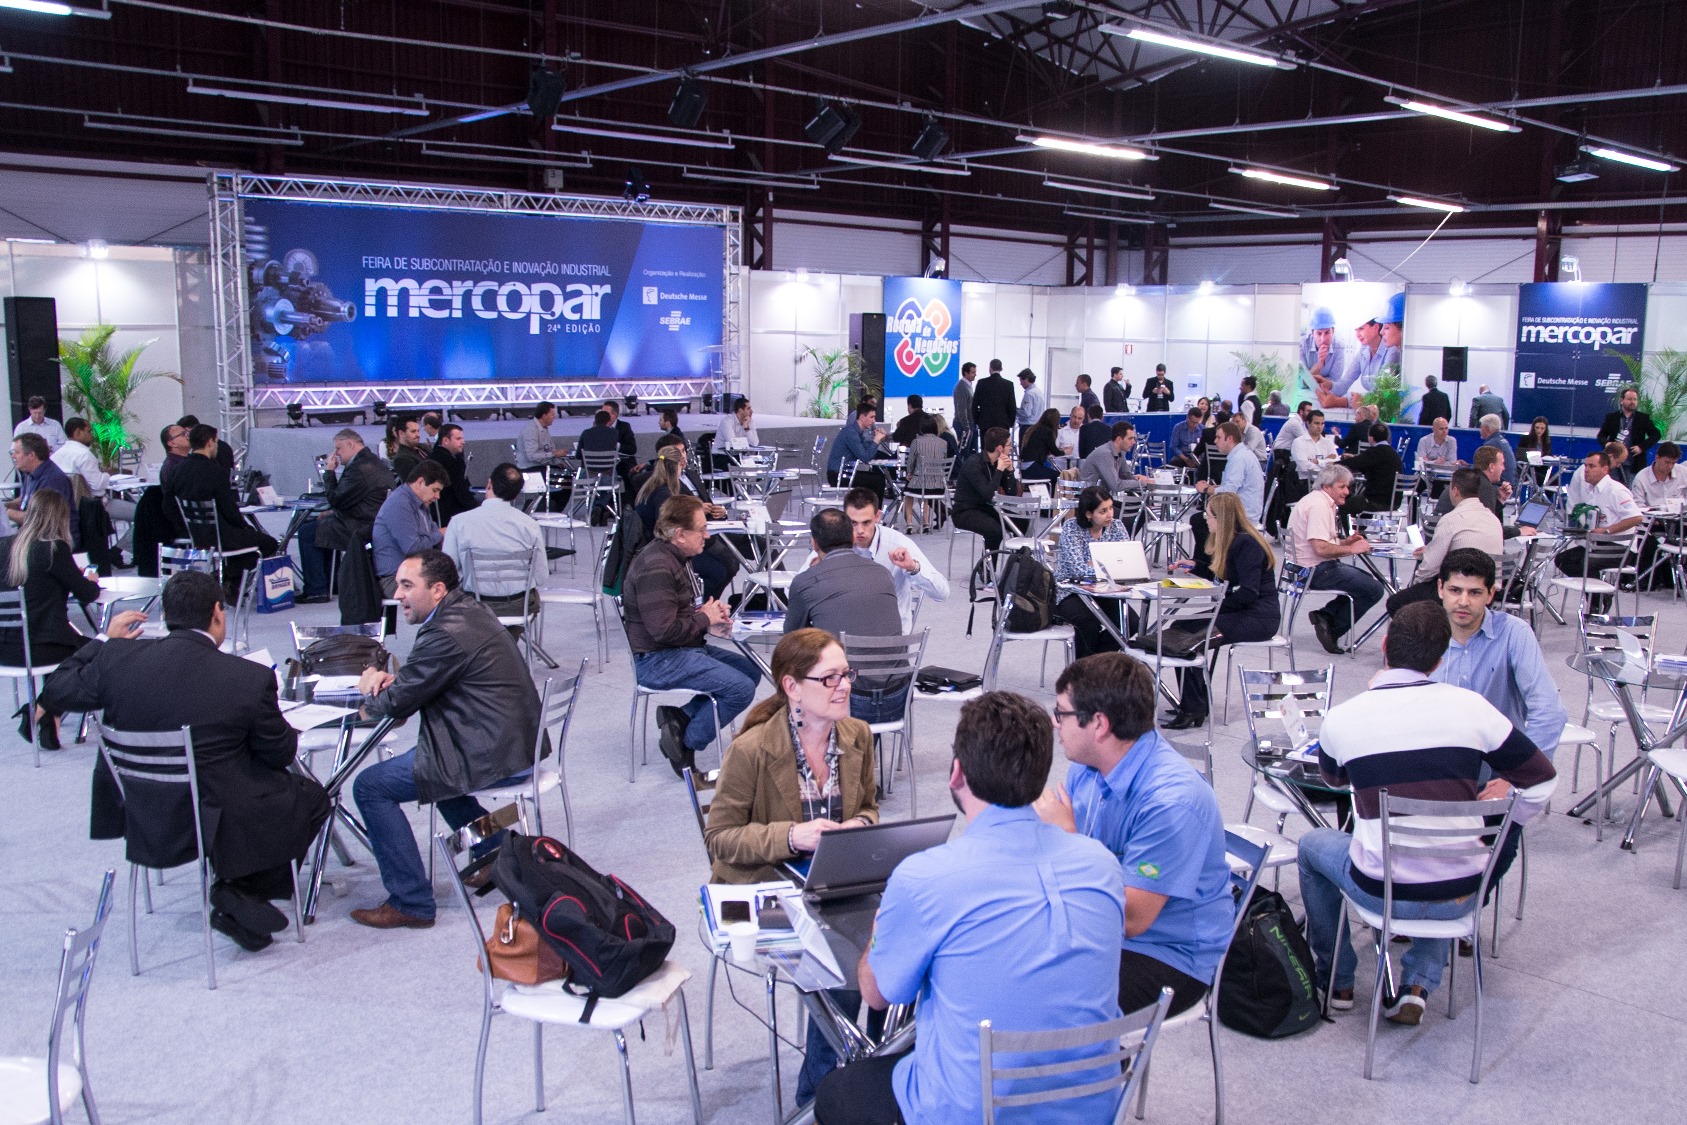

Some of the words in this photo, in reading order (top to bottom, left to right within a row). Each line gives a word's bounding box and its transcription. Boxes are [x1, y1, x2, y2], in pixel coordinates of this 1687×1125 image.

[362, 256, 392, 269] FEIRA
[394, 257, 408, 270] DE
[410, 257, 502, 275] SUBCONTRATAÇÃO
[504, 261, 510, 273] E
[512, 261, 559, 277] INOVAÇÃO
[561, 263, 612, 277] INDUSTRIAL
[643, 269, 674, 277] Organização
[660, 292, 688, 301] Deutsche
[688, 293, 708, 301] Messe
[364, 278, 612, 335] mercopar
[660, 317, 692, 325] SEBRAE
[886, 316, 922, 333] Rodada
[1541, 316, 1583, 325] SUBCONTRATAÇÃO
[1588, 317, 1611, 325] INOVAÇÃO
[565, 322, 601, 335] EDIÇÃO
[922, 326, 932, 337] de
[1520, 325, 1639, 351] mercopar
[1537, 377, 1566, 386] Deutsche
[1567, 378, 1589, 386] Messe
